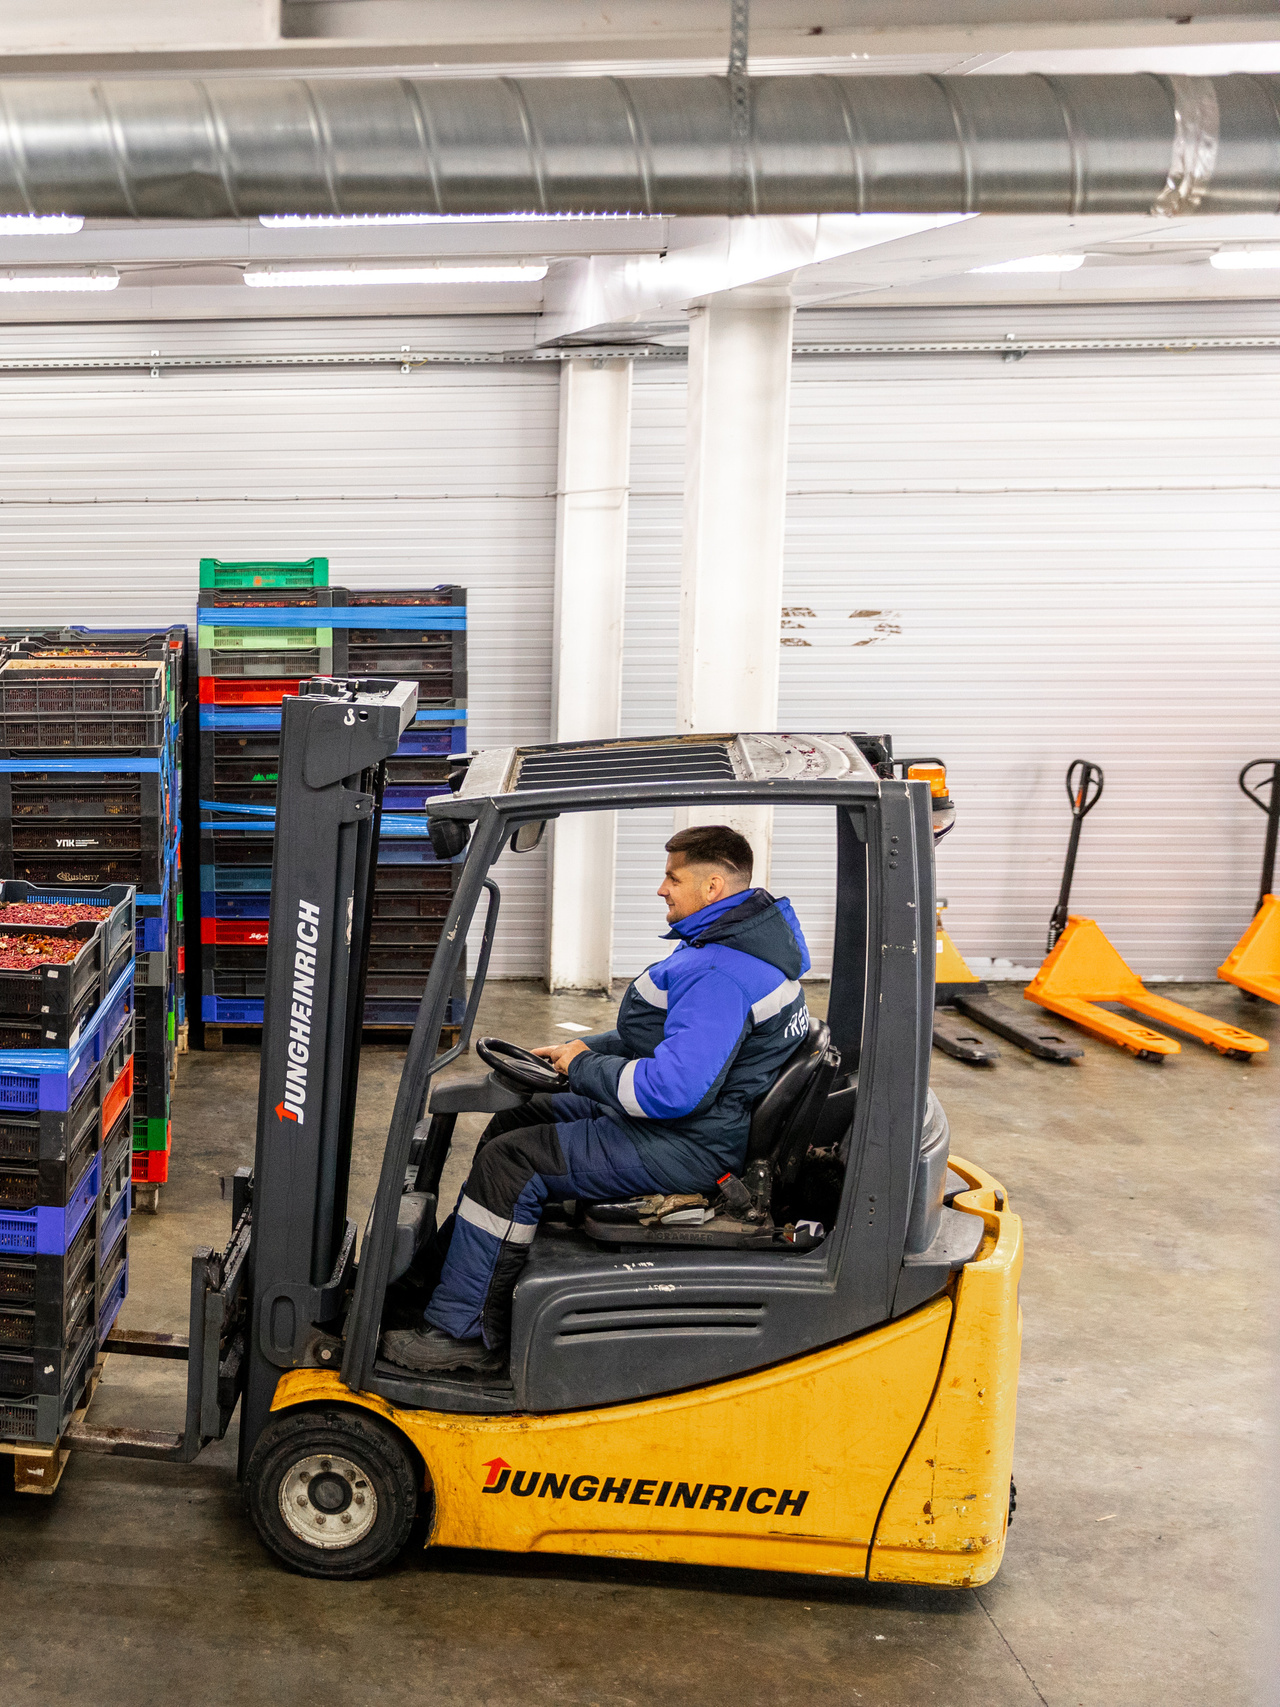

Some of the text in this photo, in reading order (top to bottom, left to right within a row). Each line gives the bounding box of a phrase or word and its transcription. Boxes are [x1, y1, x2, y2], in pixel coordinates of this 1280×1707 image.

[55, 838, 75, 848] УПК
[65, 871, 100, 882] Rusberry
[280, 899, 321, 1126] JUNGHEINRICH
[655, 1231, 714, 1242] GRAMMER
[482, 1464, 810, 1518] JUNGHEINRICH
